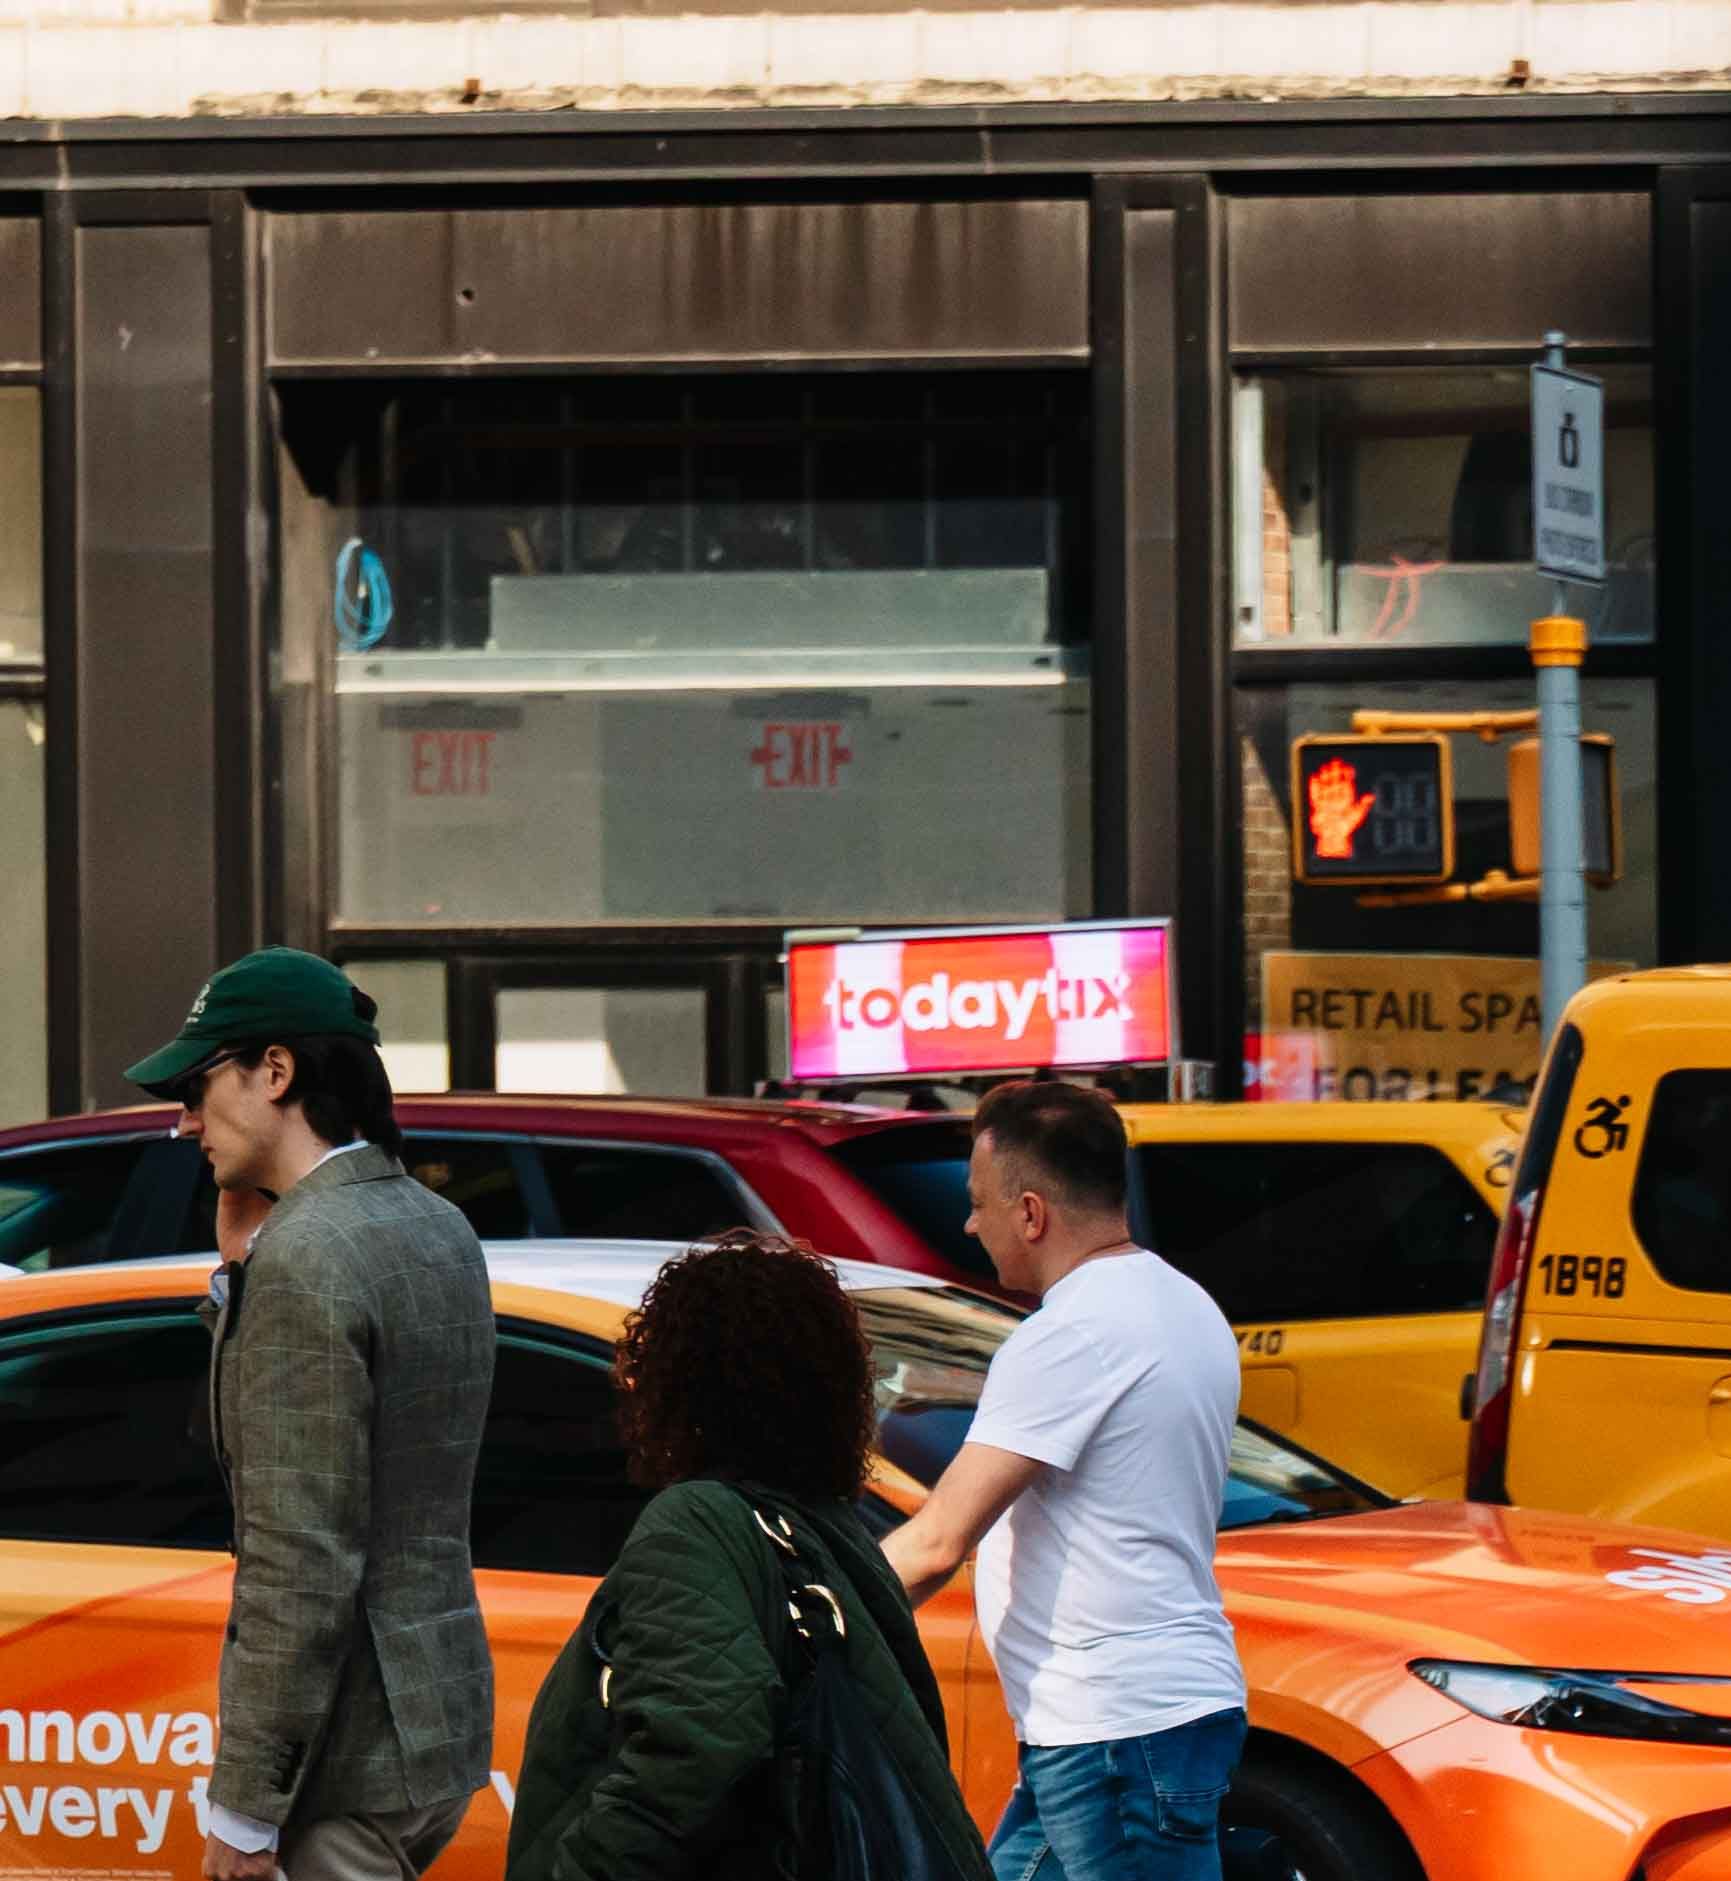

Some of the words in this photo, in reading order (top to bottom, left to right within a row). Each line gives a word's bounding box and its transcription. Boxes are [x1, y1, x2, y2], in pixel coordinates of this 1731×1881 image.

[411, 732, 496, 795] EXIT
[763, 724, 842, 788] EXIT
[823, 972, 1132, 1041] todaytix
[1290, 986, 1448, 1031] RETAIL
[1459, 990, 1542, 1034] SPA
[0, 1786, 174, 1854] very
